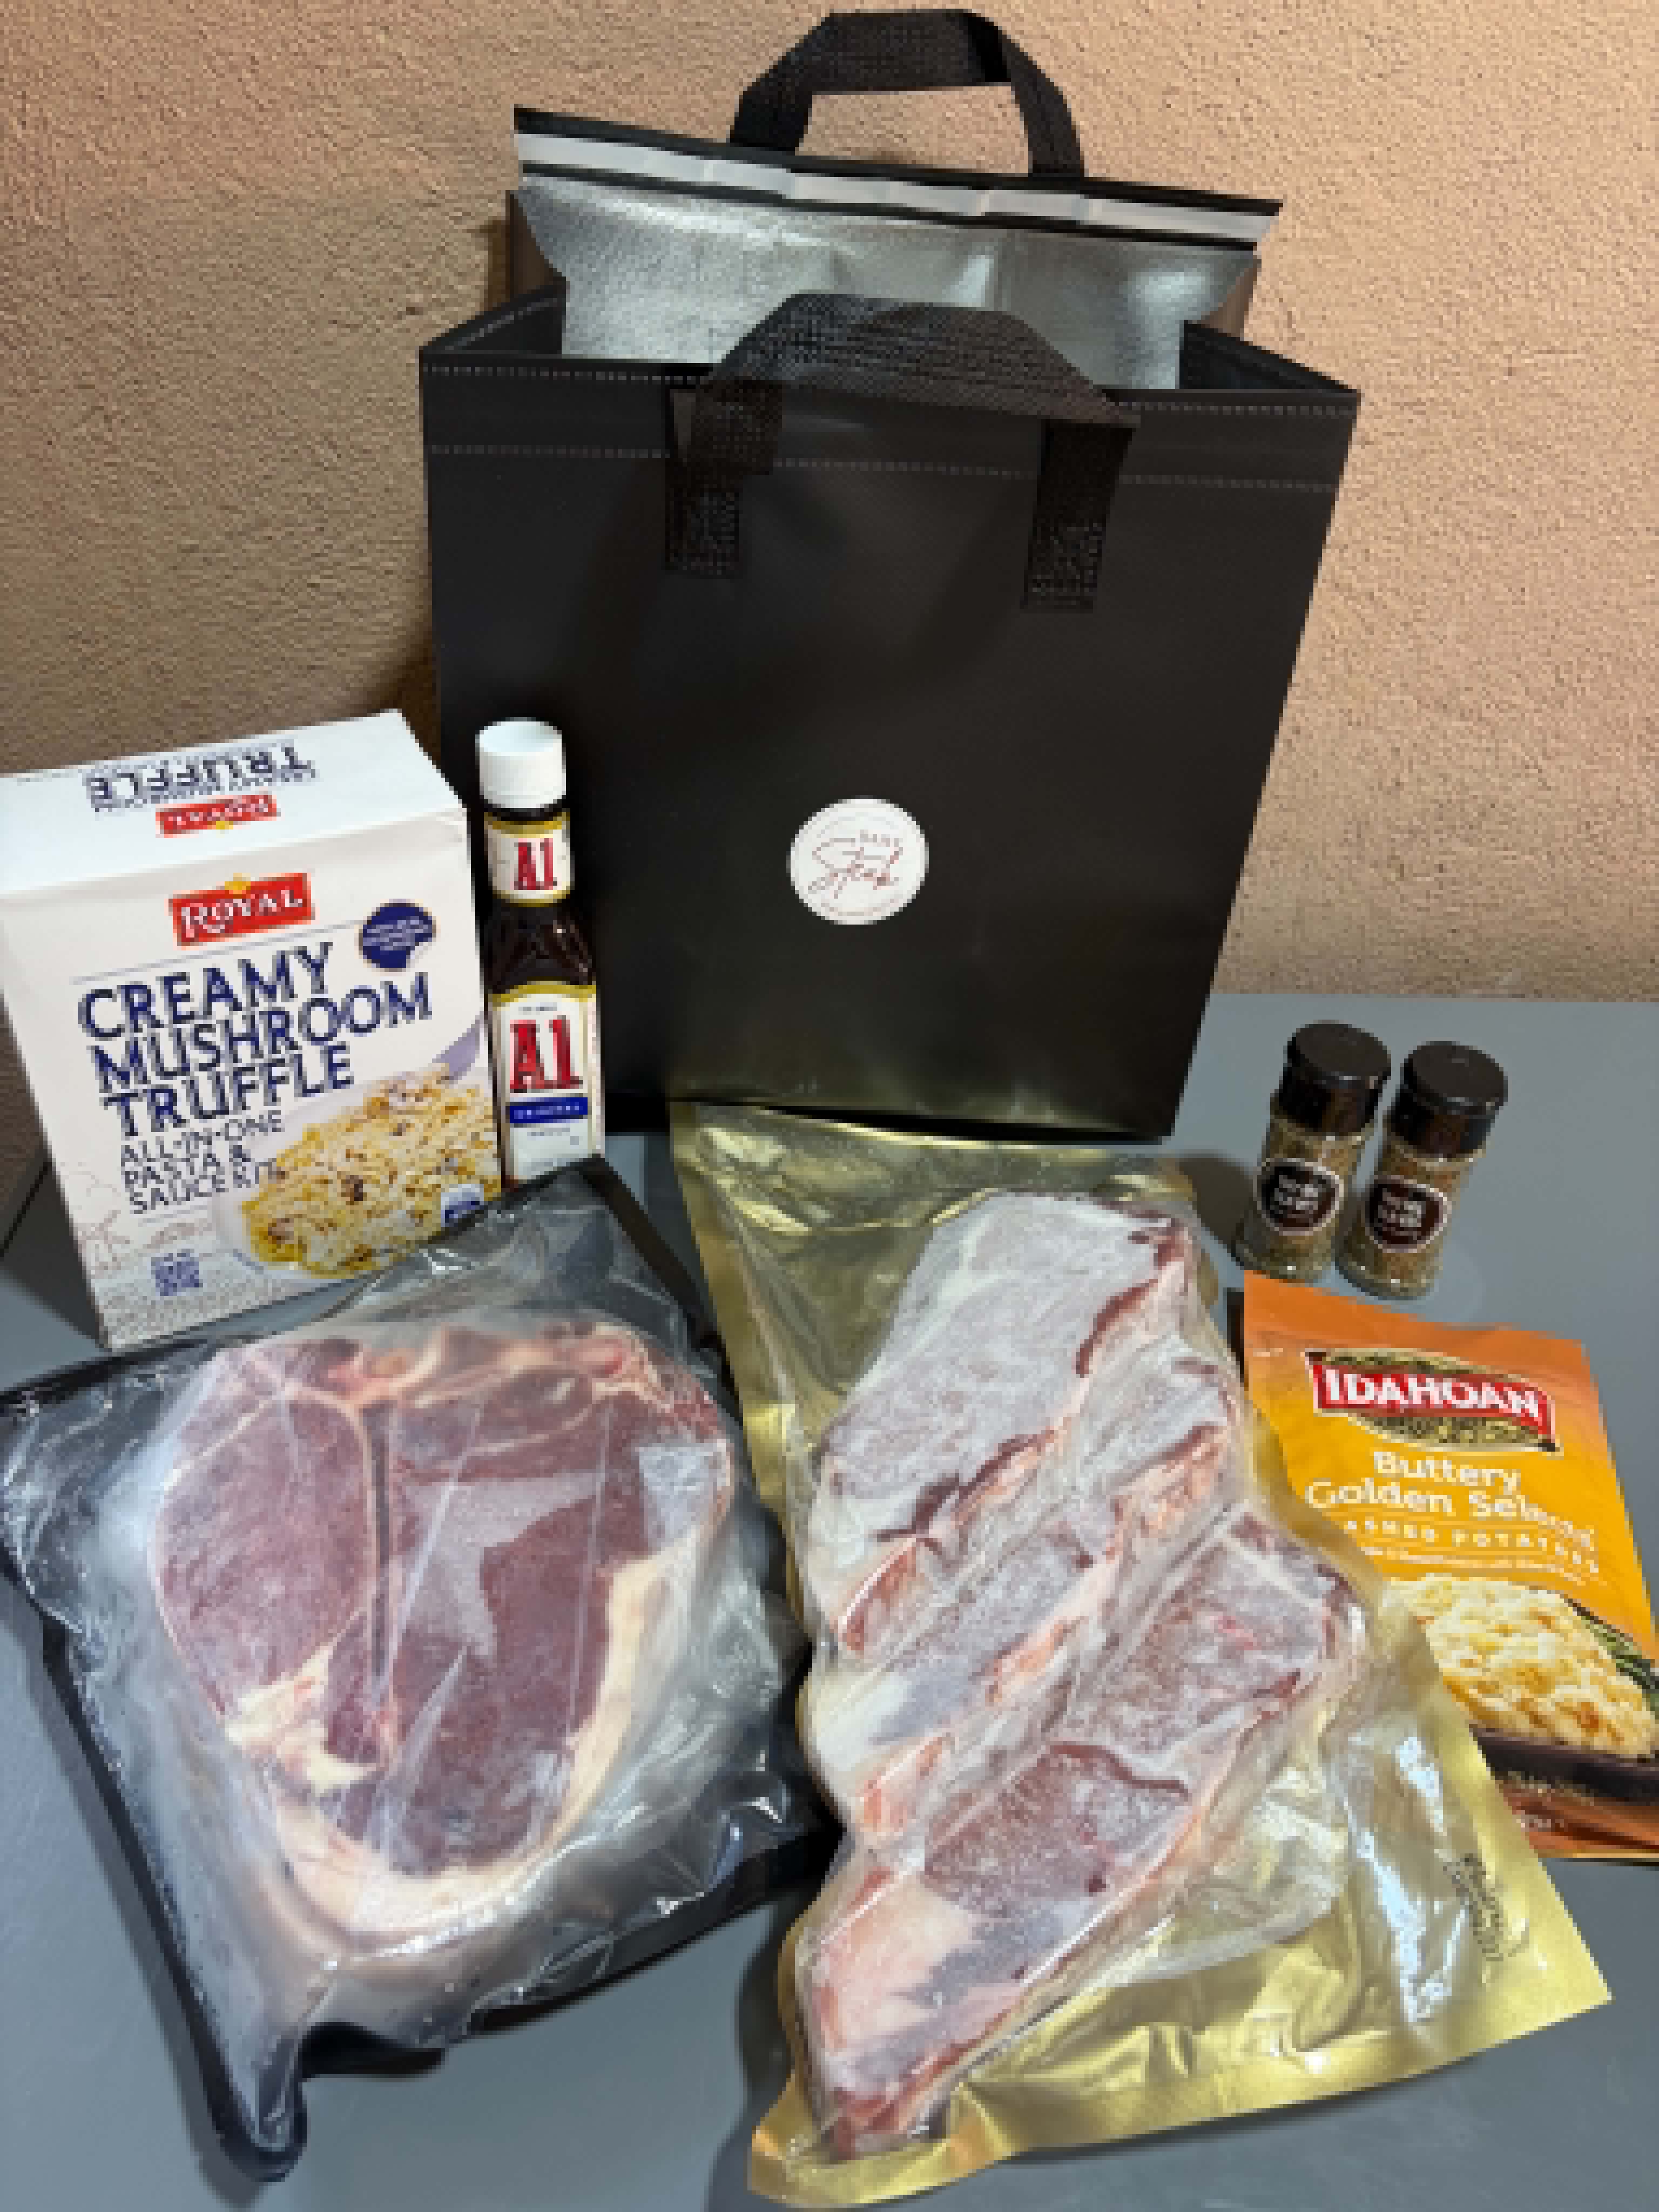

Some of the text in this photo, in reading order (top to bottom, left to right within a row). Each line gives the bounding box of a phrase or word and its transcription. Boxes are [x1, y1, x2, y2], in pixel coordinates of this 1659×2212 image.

[86, 743, 313, 801] TRUFFLE
[180, 888, 304, 940] ROYAL
[78, 942, 333, 1040] CREAMY
[87, 972, 433, 1093] MUSHROOM
[102, 1041, 355, 1138] TRUFFLE
[123, 1144, 252, 1192] PASTA &
[129, 1175, 227, 1215] SAUCE
[1325, 1367, 1540, 1418] IDAHOAN
[1304, 1476, 1454, 1516] Golden
[1373, 1451, 1522, 1497] Buttery
[1344, 1516, 1439, 1545] ASHED
